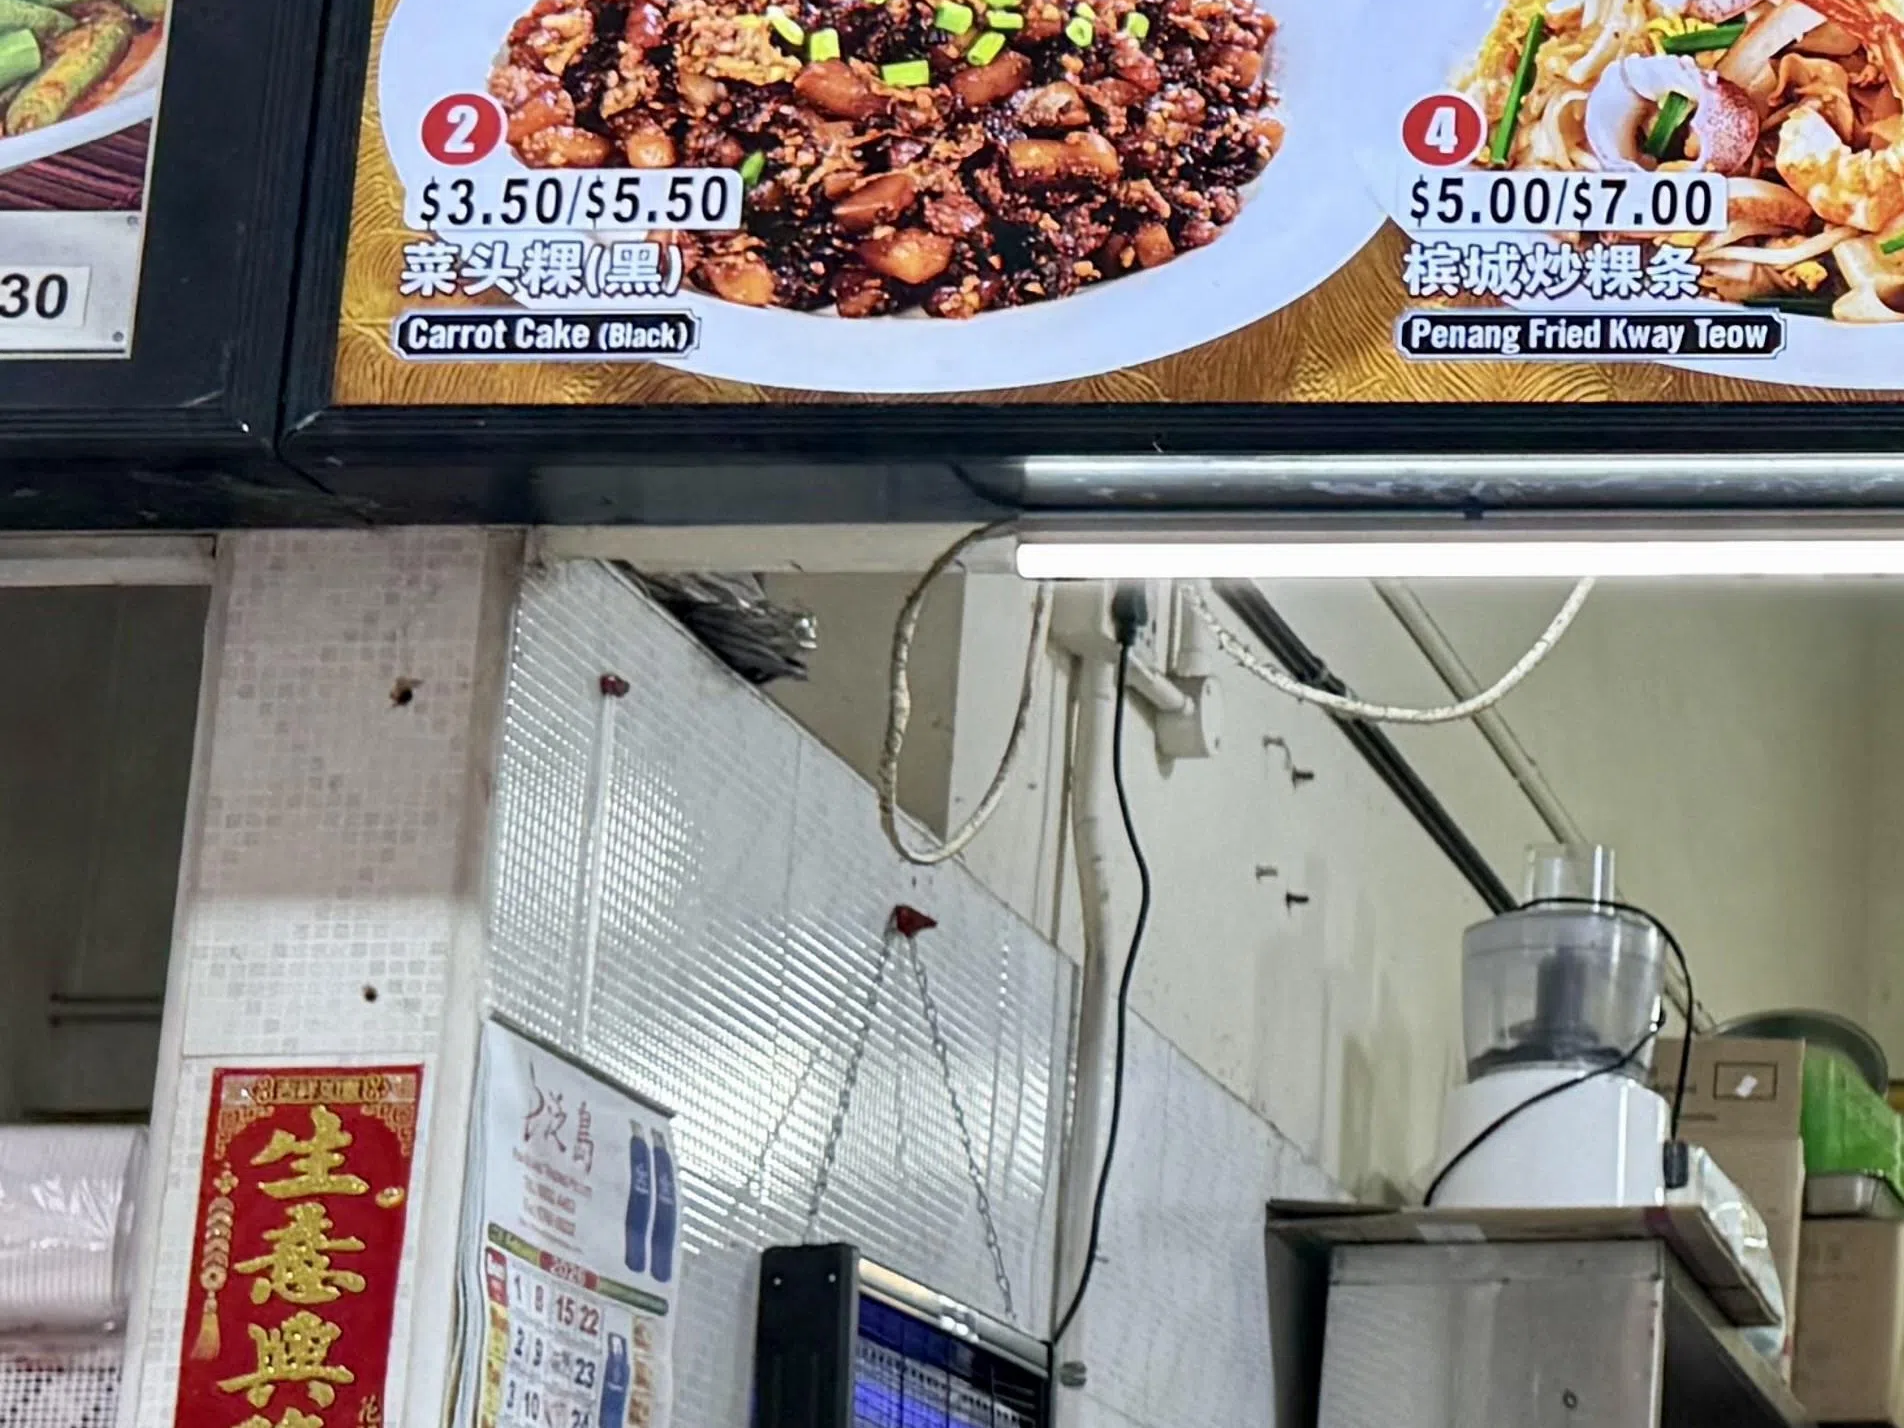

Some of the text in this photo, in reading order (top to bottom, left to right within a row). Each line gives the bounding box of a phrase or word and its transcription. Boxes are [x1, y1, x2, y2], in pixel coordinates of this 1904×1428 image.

[443, 104, 480, 154] 2
[1425, 105, 1459, 154] 4
[420, 175, 728, 231] $3.50/$5.50
[1410, 174, 1712, 227] $5.00/$7.00
[399, 240, 684, 298] 菜头粿(黑)
[1403, 242, 1702, 299] 槟城炒粿条
[408, 318, 688, 351] Carrot Cake (Black)
[1410, 318, 1768, 356] Penang Fried Kway Teow
[557, 1296, 574, 1325] 15
[580, 1306, 600, 1336] 22
[575, 1358, 595, 1388] 23
